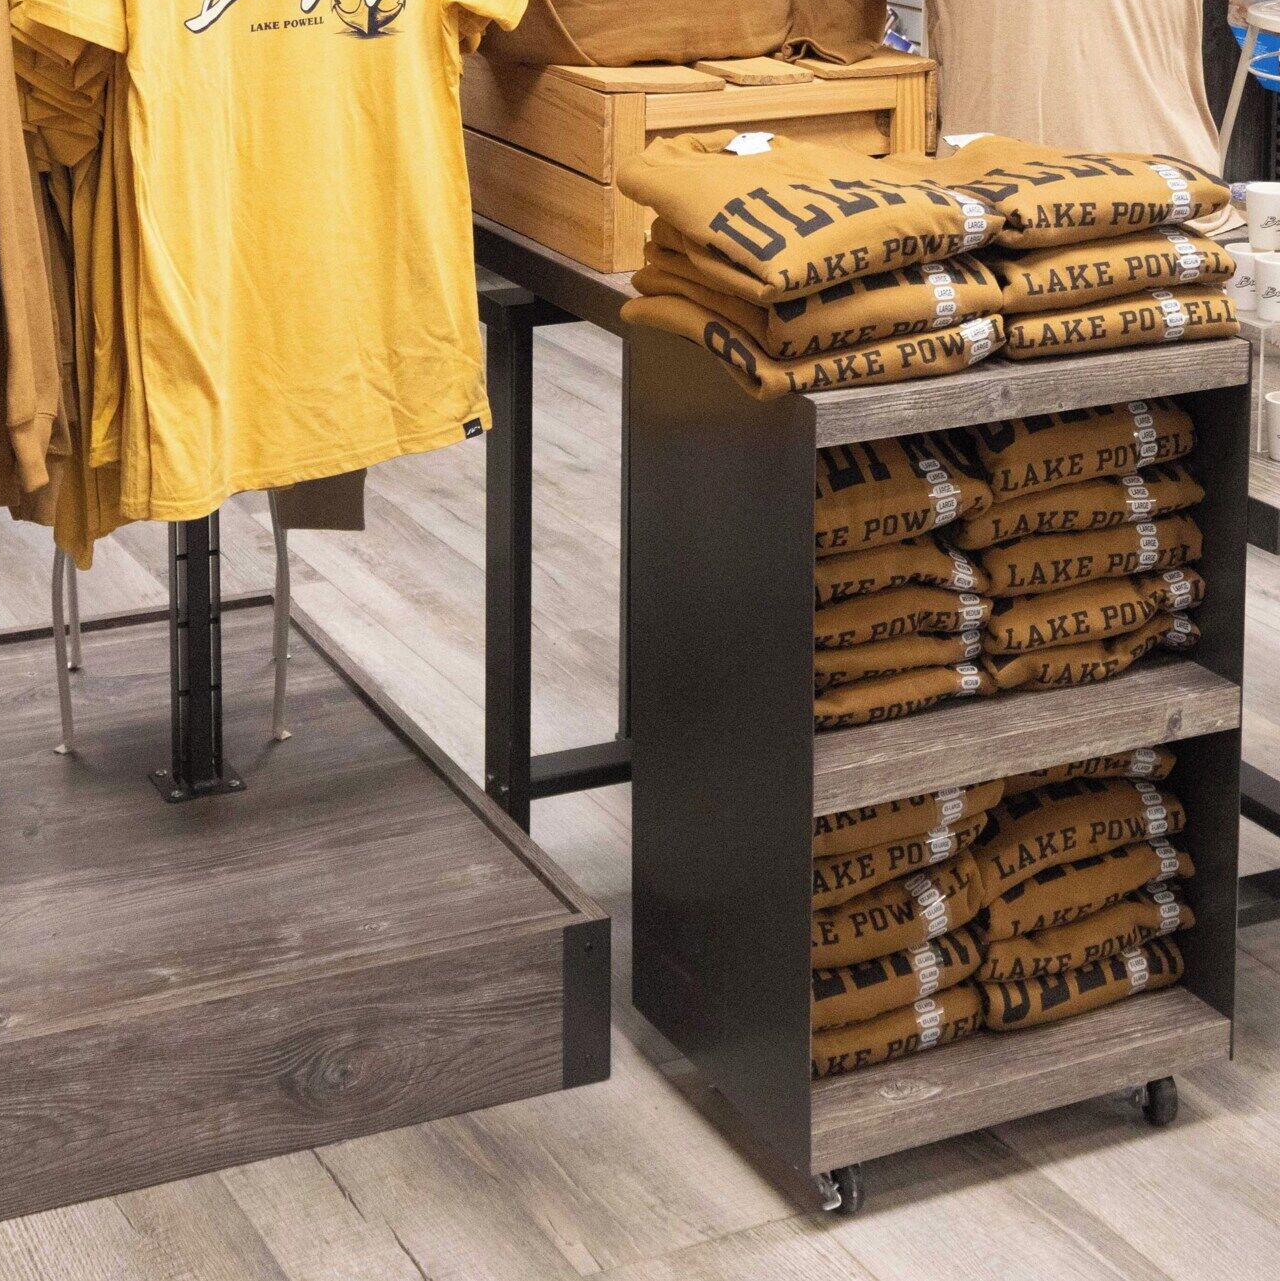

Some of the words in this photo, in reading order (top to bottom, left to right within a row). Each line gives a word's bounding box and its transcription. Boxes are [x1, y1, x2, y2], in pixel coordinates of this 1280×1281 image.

[250, 22, 281, 33] LAKE
[283, 16, 325, 29] POWELL
[964, 205, 983, 215] LARGE
[967, 220, 985, 231] LARGE
[778, 246, 870, 293] LAKE
[883, 233, 966, 262] POWE
[1023, 261, 1114, 297] LAKE
[936, 287, 954, 298] LARGE
[938, 303, 955, 314] LARGE
[1013, 315, 1107, 349] LAKE
[1120, 299, 1238, 335] POELL
[973, 341, 990, 352] LARGE
[785, 350, 886, 393] LAKE
[999, 453, 1085, 492] LAKE
[938, 498, 956, 511] LARGE
[862, 509, 931, 542] POW
[991, 510, 1080, 541] LAKE
[1142, 538, 1157, 548] LARGE
[1007, 555, 1094, 588] LAKE
[1004, 609, 1091, 650] LAKE
[991, 826, 1078, 881] LAKE
[812, 854, 875, 893] AKE
[987, 952, 1072, 981] LAKE
